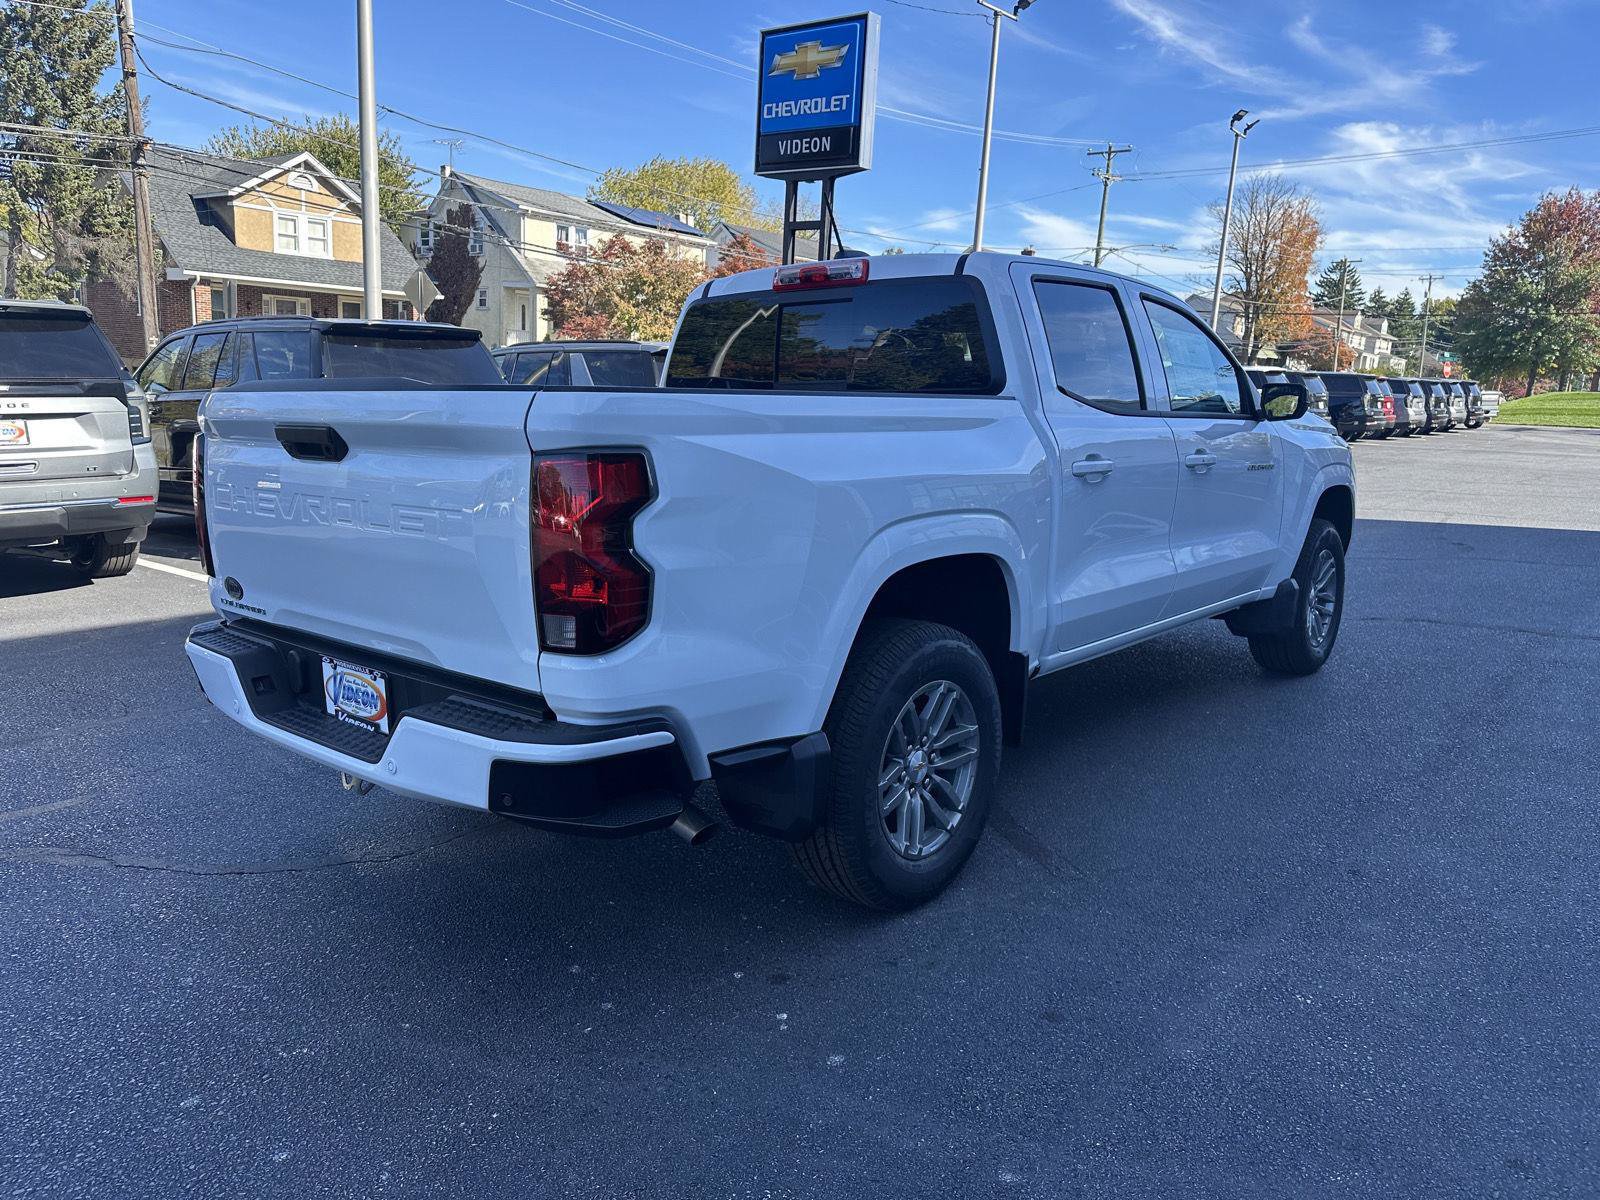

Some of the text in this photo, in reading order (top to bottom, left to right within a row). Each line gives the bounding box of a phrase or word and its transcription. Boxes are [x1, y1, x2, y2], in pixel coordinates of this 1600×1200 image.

[763, 94, 850, 119] CHEVROLET
[778, 136, 831, 155] VIDEON
[213, 482, 466, 541] CHEVROLET
[333, 671, 379, 712] VIDEON
